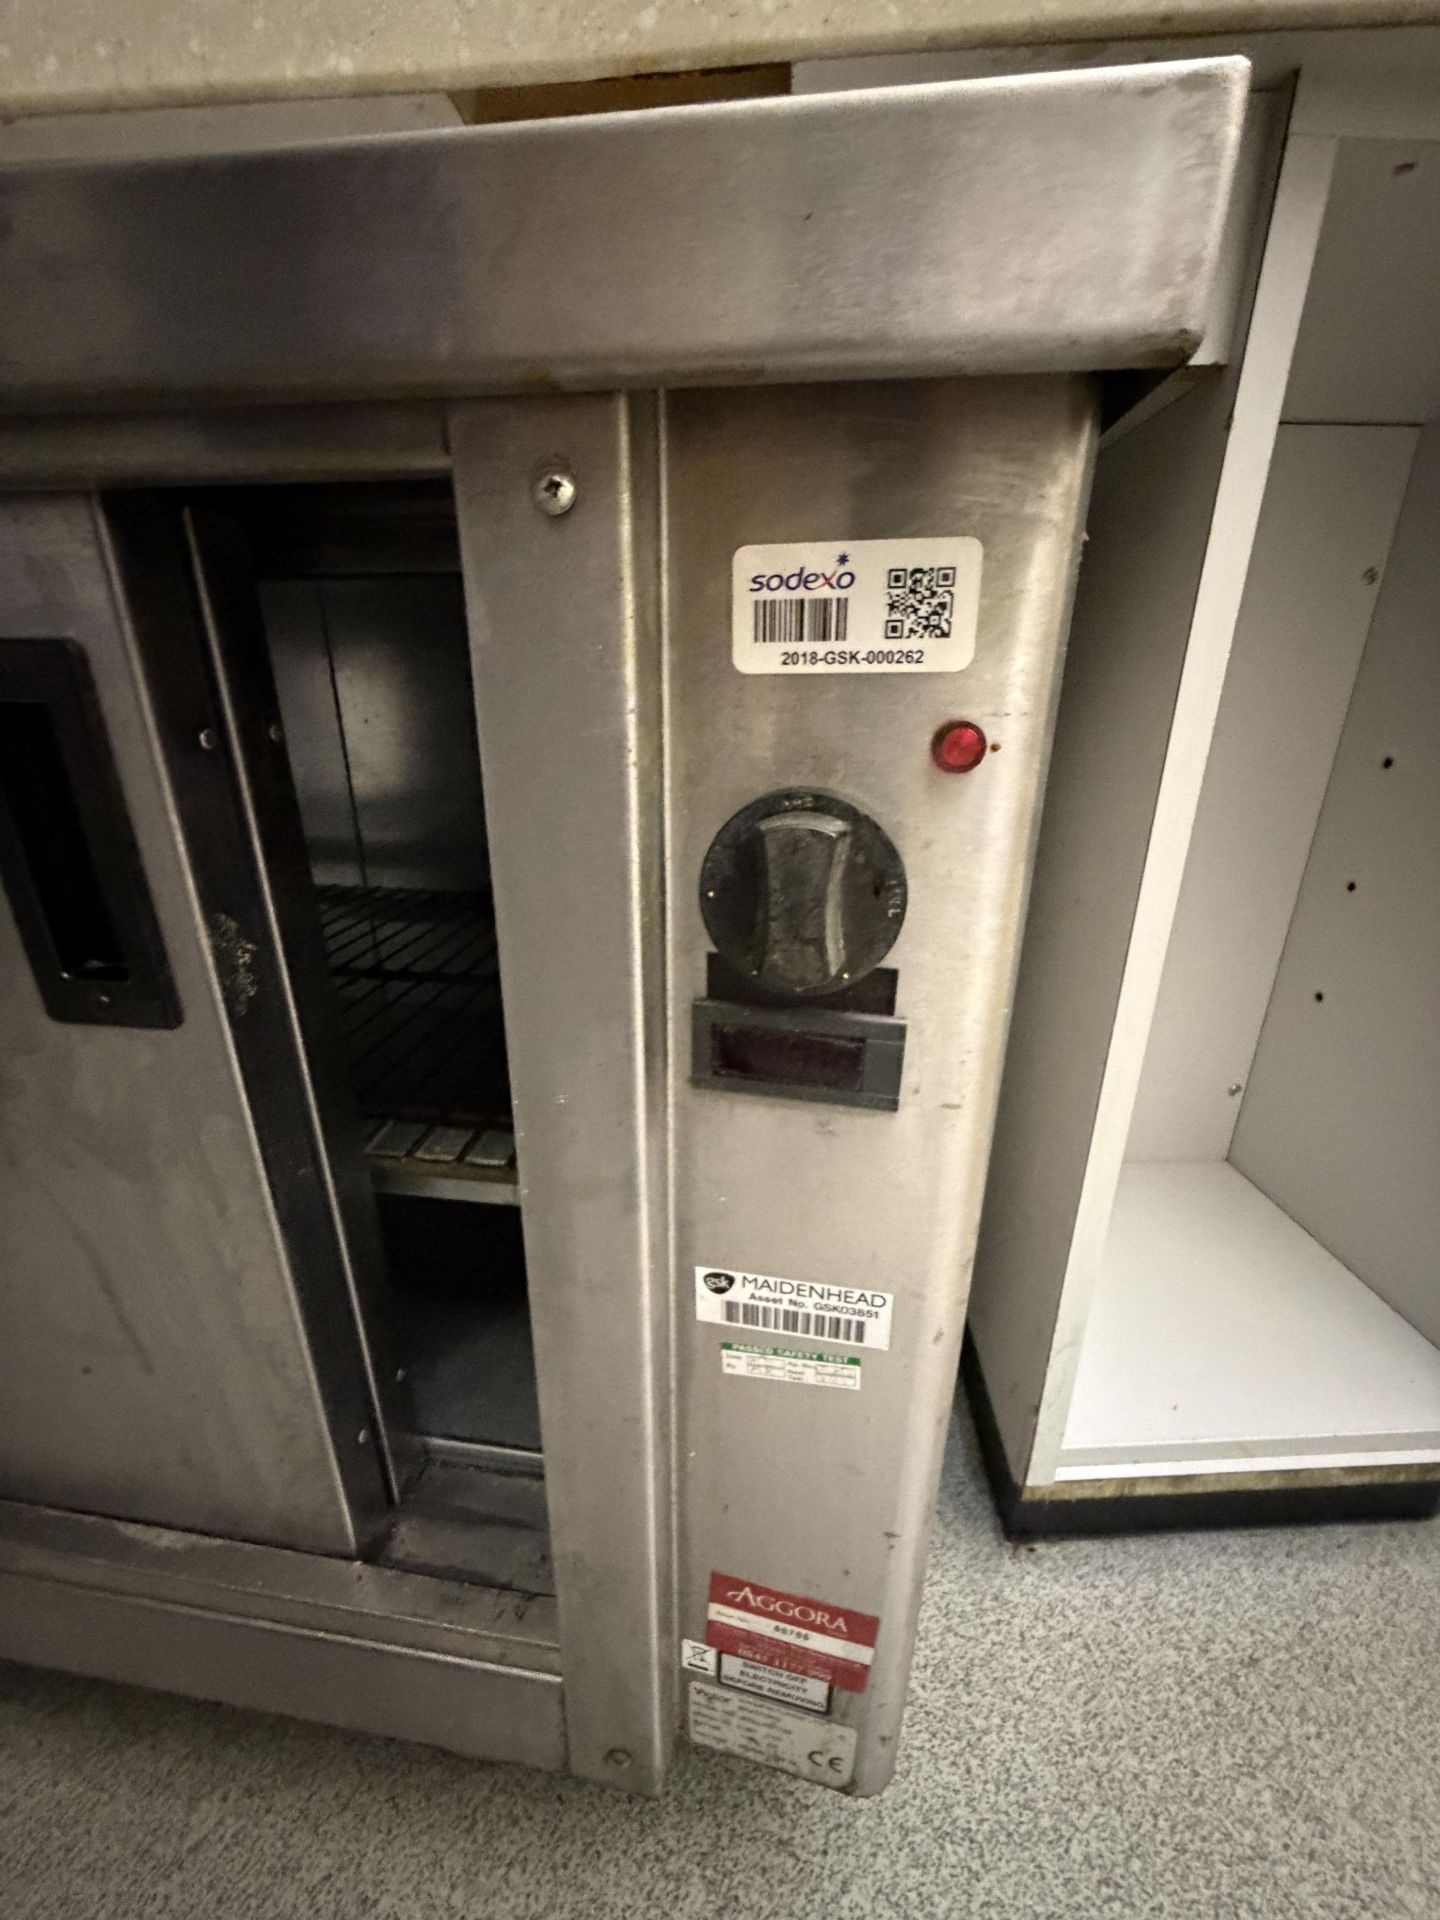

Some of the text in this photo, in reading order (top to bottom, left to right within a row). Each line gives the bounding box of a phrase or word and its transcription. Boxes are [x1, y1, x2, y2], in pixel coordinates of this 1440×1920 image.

[749, 567, 856, 592] sodexo
[781, 650, 925, 665] 2018-GSK-000262
[742, 1275, 886, 1309] MAIDENHEAD
[749, 1292, 783, 1305] Asset
[788, 1298, 808, 1309] No.
[822, 1354, 849, 1364] TEST
[726, 1586, 848, 1633] AGGORA
